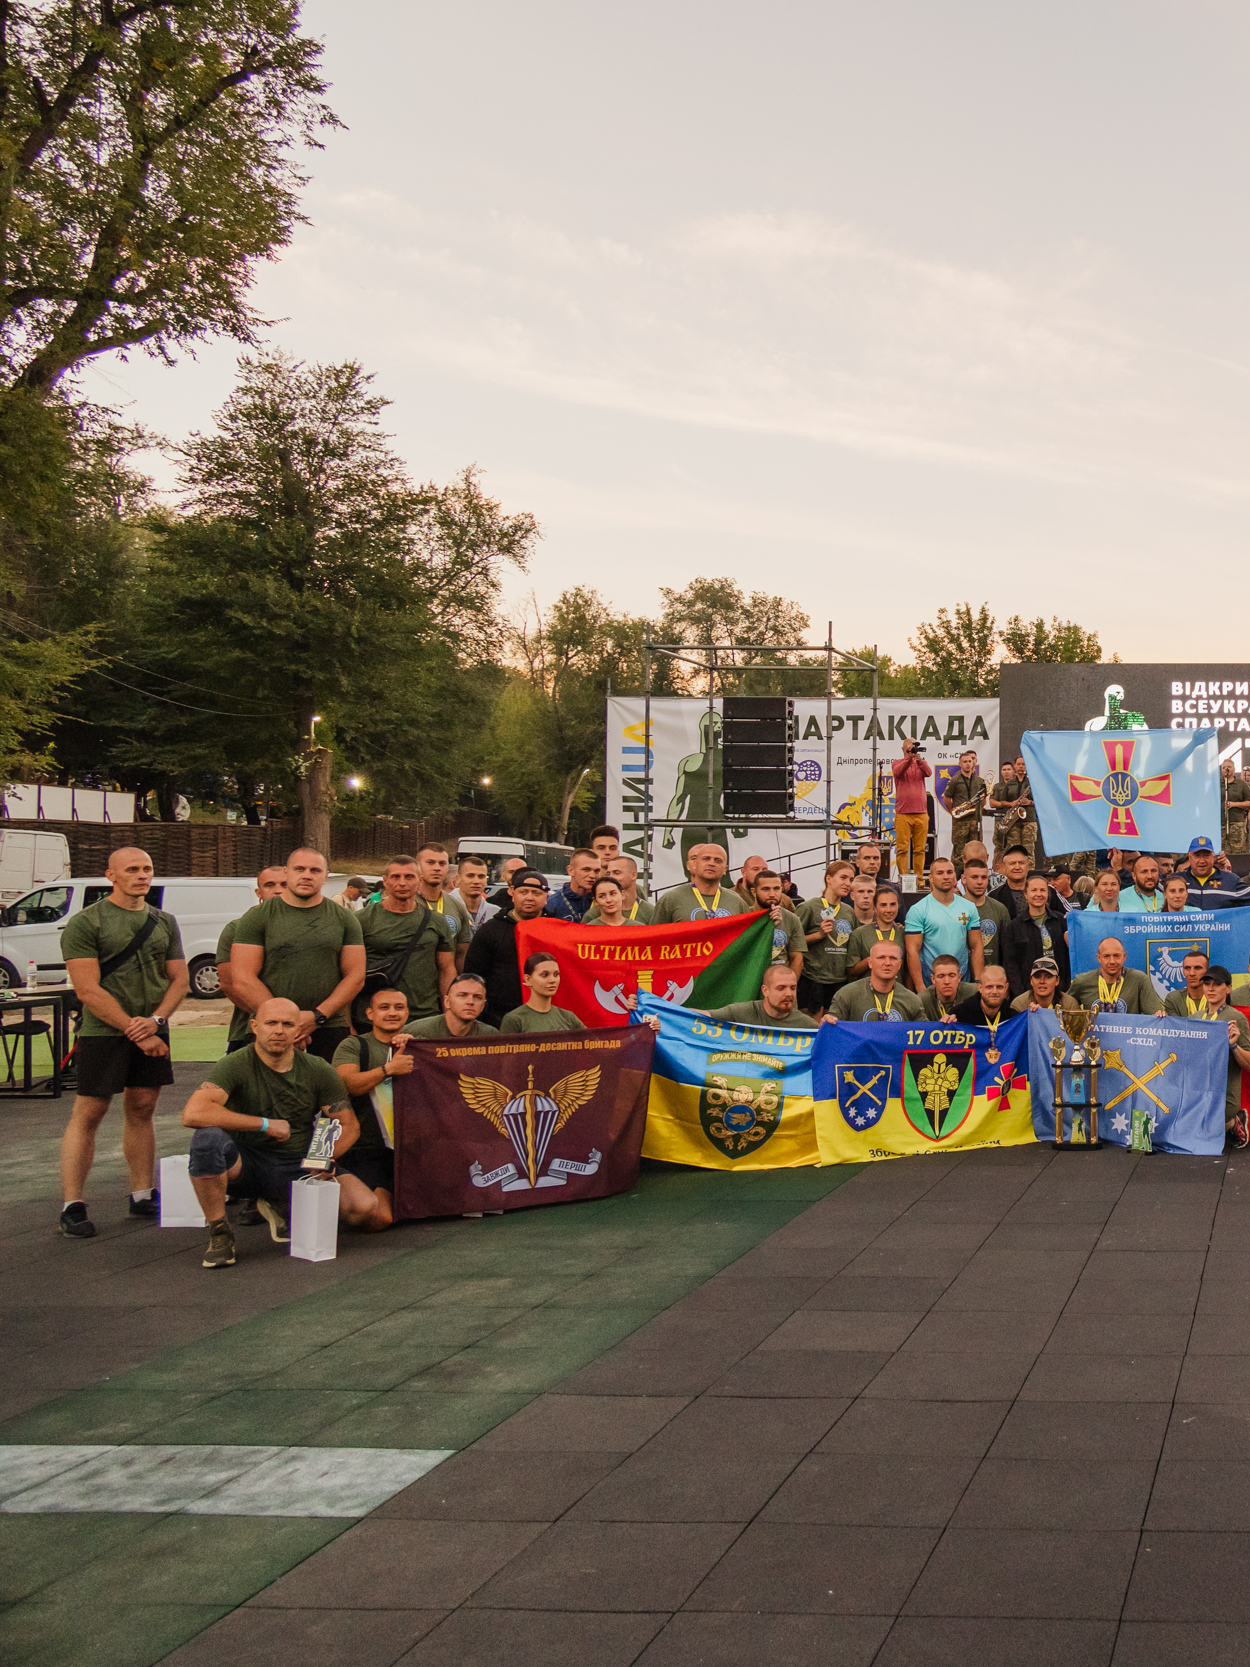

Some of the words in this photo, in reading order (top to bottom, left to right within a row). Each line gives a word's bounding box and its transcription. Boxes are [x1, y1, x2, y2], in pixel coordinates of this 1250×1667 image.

[793, 714, 990, 746] АРТАКІАДА
[1190, 913, 1215, 922] СИЛИ
[1123, 923, 1173, 934] ЗБРОЙНИХ
[1174, 923, 1193, 933] СИЛ
[1194, 922, 1231, 932] УКРАЇНИ
[577, 943, 653, 961] ULTIMA
[659, 941, 714, 960] RATIO
[691, 1018, 723, 1038] 53
[1088, 1024, 1133, 1034] АТИВНЕ
[1135, 1027, 1208, 1039] КОМАНДУВАННЯ
[436, 1047, 449, 1058] 25
[449, 1046, 487, 1058] окрема
[487, 1041, 583, 1055] повітряно-десантна
[584, 1039, 622, 1051] бригада
[906, 1030, 925, 1045] 17
[929, 1029, 976, 1049] ОТБр
[1126, 1037, 1157, 1047] «СХІД»
[743, 1051, 752, 1061] НЕ
[752, 1054, 784, 1071] ЗНІМАЙТЕ
[1074, 1083, 1081, 1094] 2
[481, 1165, 511, 1185] ЗАВЖДИ
[558, 1160, 588, 1173] ПЕРШІ
